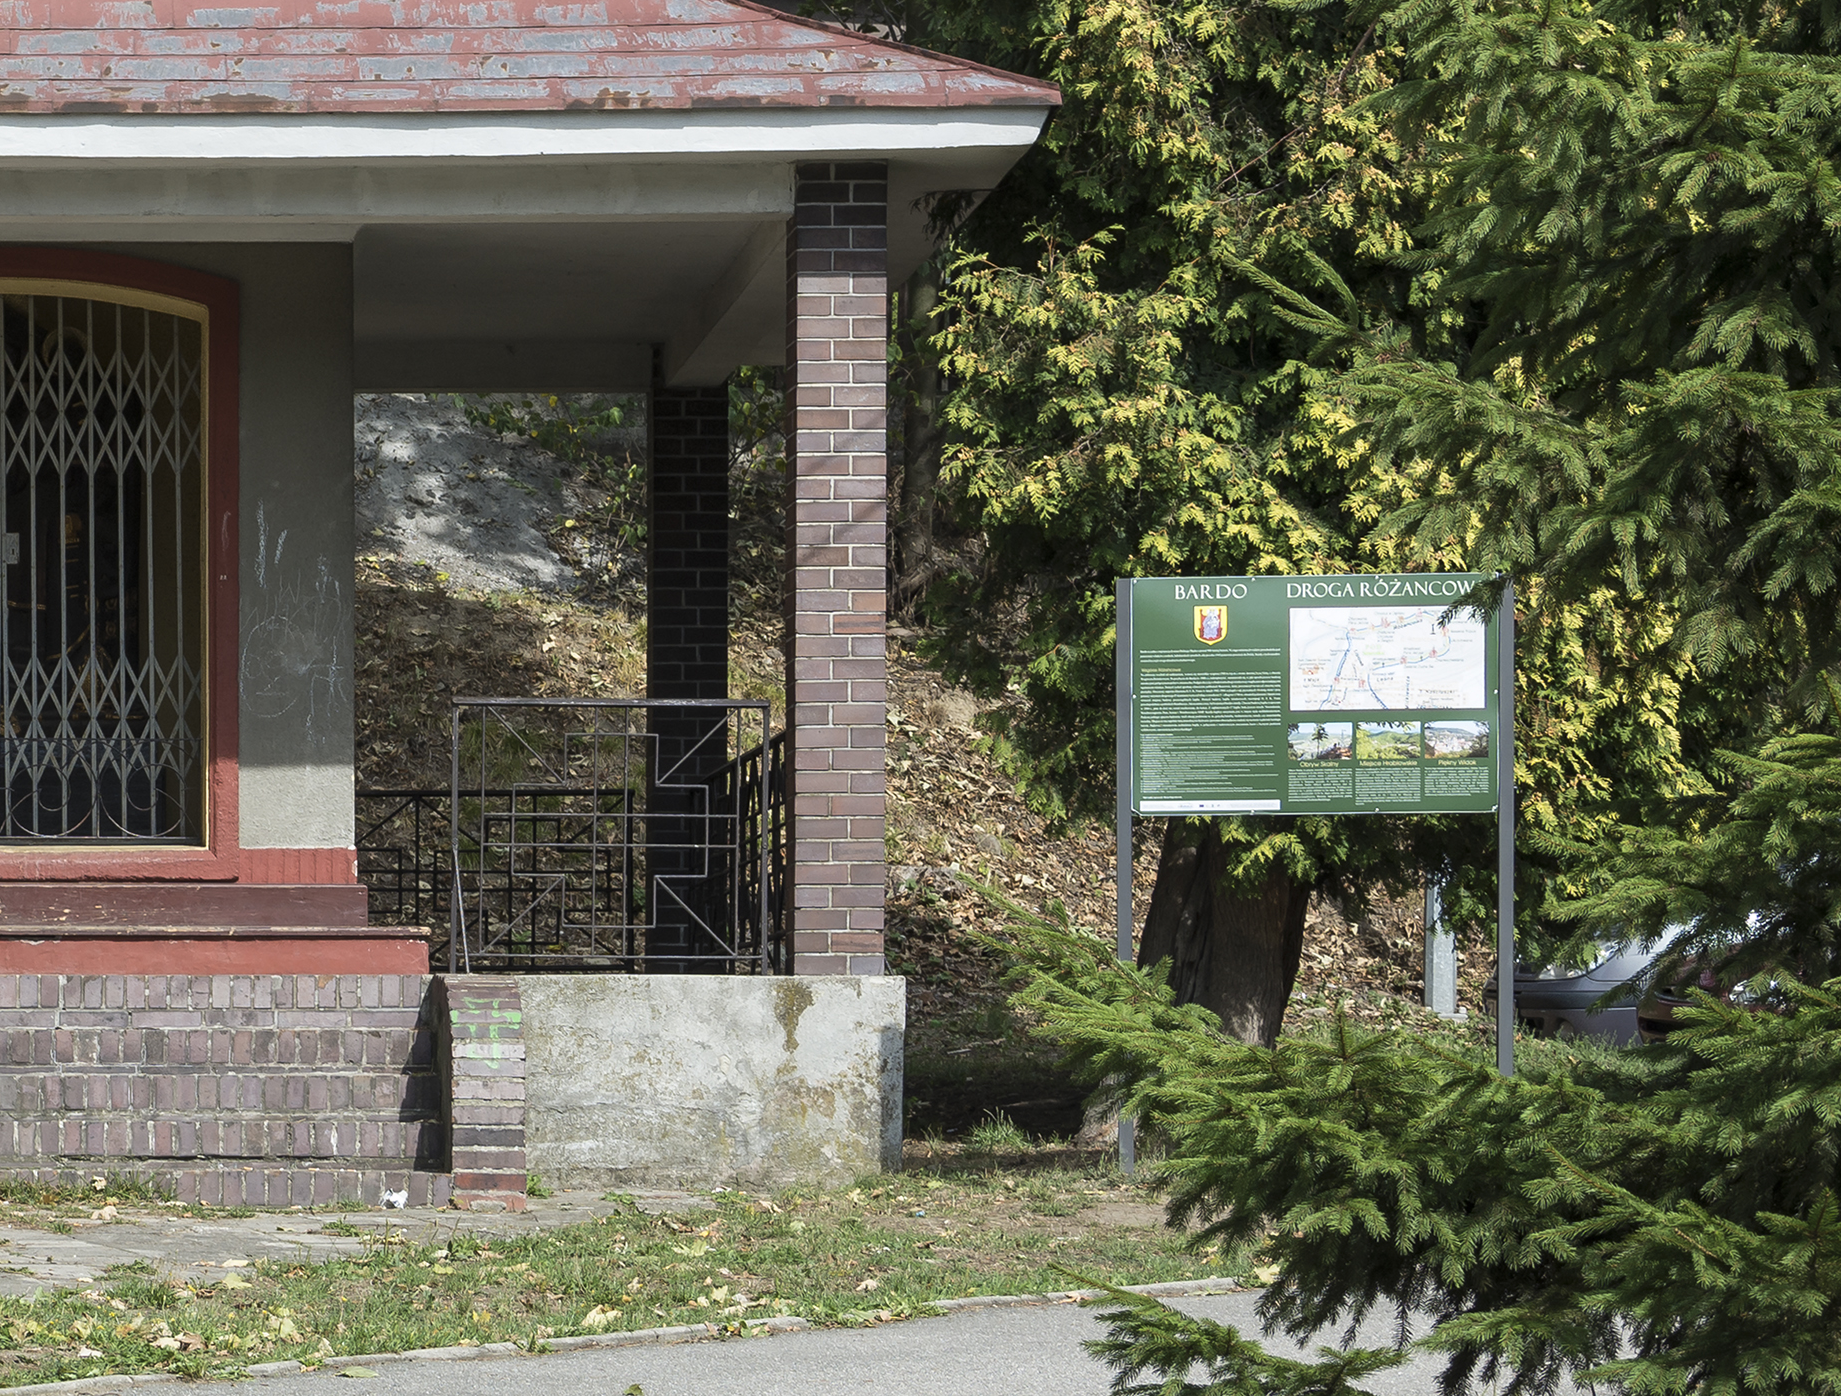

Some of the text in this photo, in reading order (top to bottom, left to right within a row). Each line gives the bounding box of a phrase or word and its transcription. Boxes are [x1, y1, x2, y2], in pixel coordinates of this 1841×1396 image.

[1174, 583, 1248, 600] BARDO
[1286, 578, 1476, 598] DROGA RÓŻANCOW
